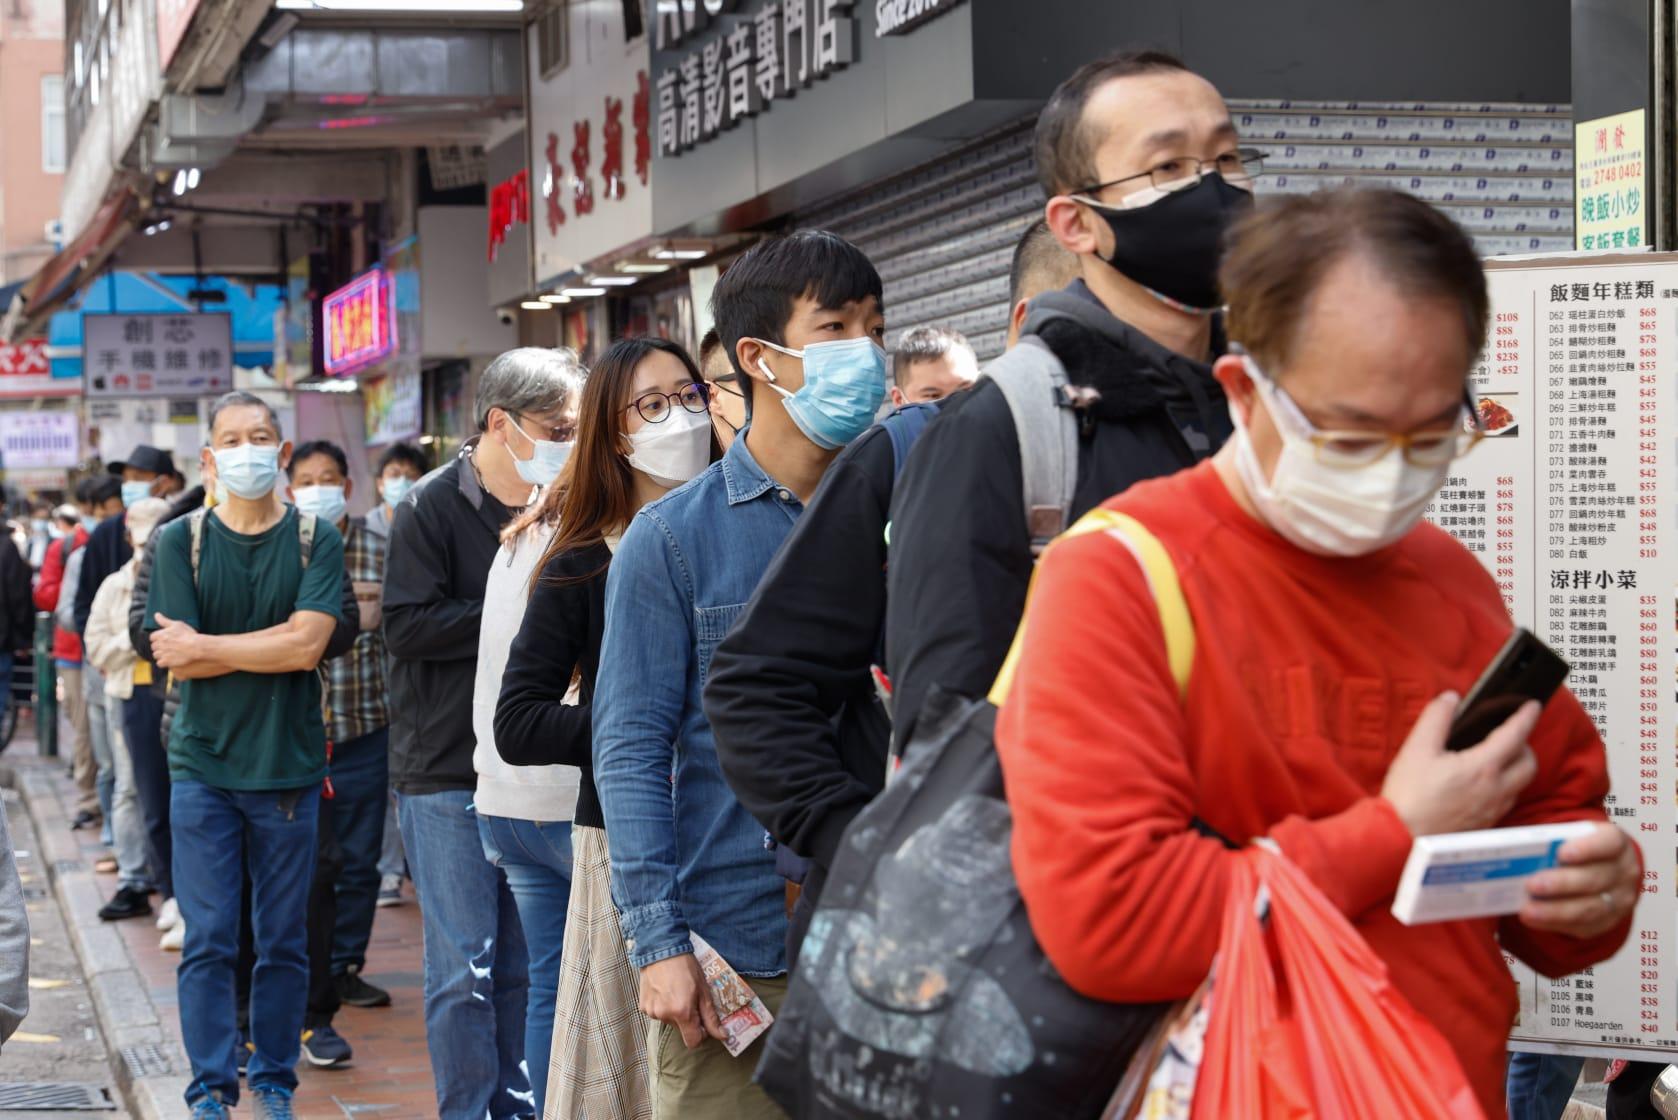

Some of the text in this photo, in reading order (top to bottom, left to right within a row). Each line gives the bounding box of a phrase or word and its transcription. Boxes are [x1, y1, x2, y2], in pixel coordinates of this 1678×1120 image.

[657, 0, 837, 157] 高清影音專門店
[1594, 165, 1616, 185] 2748
[1618, 162, 1641, 179] 0402
[1582, 187, 1640, 222] 晚飯小炒
[1550, 280, 1655, 302] 飯麵年糕類
[1496, 313, 1519, 322] $108
[1550, 312, 1564, 320] D62
[1639, 308, 1658, 317] $68
[1496, 327, 1513, 336] $88
[1550, 325, 1564, 333] D63
[1639, 321, 1658, 331] $65
[1496, 340, 1519, 349] $168
[1550, 337, 1564, 346] D64
[1639, 335, 1658, 344] $78
[1496, 353, 1519, 362] $238
[1550, 351, 1564, 360] D65
[1639, 348, 1658, 357] $68
[1550, 364, 1564, 373] D66
[1639, 361, 1658, 371] $55
[1550, 378, 1564, 386] D67
[1639, 375, 1658, 384] $45
[1550, 391, 1564, 399] D68
[1639, 388, 1658, 397] $45
[1550, 404, 1564, 413] D69
[1639, 401, 1658, 411] $55
[1550, 417, 1564, 426] D70
[1639, 415, 1658, 424] $45
[1550, 430, 1564, 439] D71
[1639, 428, 1658, 438] $45
[1550, 444, 1564, 452] D72
[1639, 442, 1658, 451] $42
[1550, 457, 1564, 465] D73
[1639, 455, 1658, 464] $42
[1550, 470, 1564, 479] D74
[1639, 468, 1658, 478] $42
[1496, 476, 1515, 486] $68
[1550, 483, 1564, 492] D75
[1639, 482, 1658, 491] $55
[1496, 490, 1515, 500] $68
[1550, 497, 1564, 506] D76
[1639, 495, 1658, 505] $55
[1496, 503, 1515, 512] $78
[1550, 510, 1564, 518] D77
[1639, 508, 1658, 518] $68
[1496, 516, 1515, 525] $68
[1550, 523, 1564, 532] D78
[1639, 522, 1658, 532] $48
[1496, 529, 1515, 538] $68
[1550, 536, 1564, 545] D79
[1639, 535, 1658, 545] $55
[1496, 543, 1515, 552] $55
[1550, 549, 1658, 559] D80 白飯 $10
[1496, 556, 1515, 565] $68
[1496, 569, 1515, 577] $98
[1550, 570, 1637, 590] 涼拌小菜
[1550, 595, 1564, 604] D81
[1639, 595, 1659, 605] $35
[1550, 608, 1659, 619] D82 麻辣牛肉 $68
[1550, 621, 1564, 630] D83
[1639, 622, 1659, 632] $60
[1550, 634, 1564, 643] D84
[1639, 636, 1659, 646] $60
[1639, 649, 1659, 659] $80
[1639, 662, 1659, 672] $48
[1639, 676, 1658, 685] $60
[1639, 689, 1658, 699] $38
[1639, 702, 1658, 713] $50
[1639, 716, 1658, 726] $48
[1639, 729, 1658, 739] $48
[1639, 742, 1659, 752] $55
[1639, 755, 1659, 766] $68
[1639, 768, 1659, 779] $60
[1640, 783, 1658, 793] $48
[1639, 796, 1659, 806] $78
[1640, 822, 1659, 833] $40
[1640, 930, 1659, 941] $12
[1640, 944, 1659, 954] $18
[1640, 957, 1659, 967] $18
[1640, 970, 1659, 981] $20
[1640, 983, 1658, 994] $35
[1551, 991, 1571, 1000] D105
[1640, 996, 1659, 1007] $38
[1551, 1004, 1571, 1014] D106
[1640, 1010, 1659, 1020] $24
[1551, 1018, 1659, 1033] D107 Hoegaarden $40
